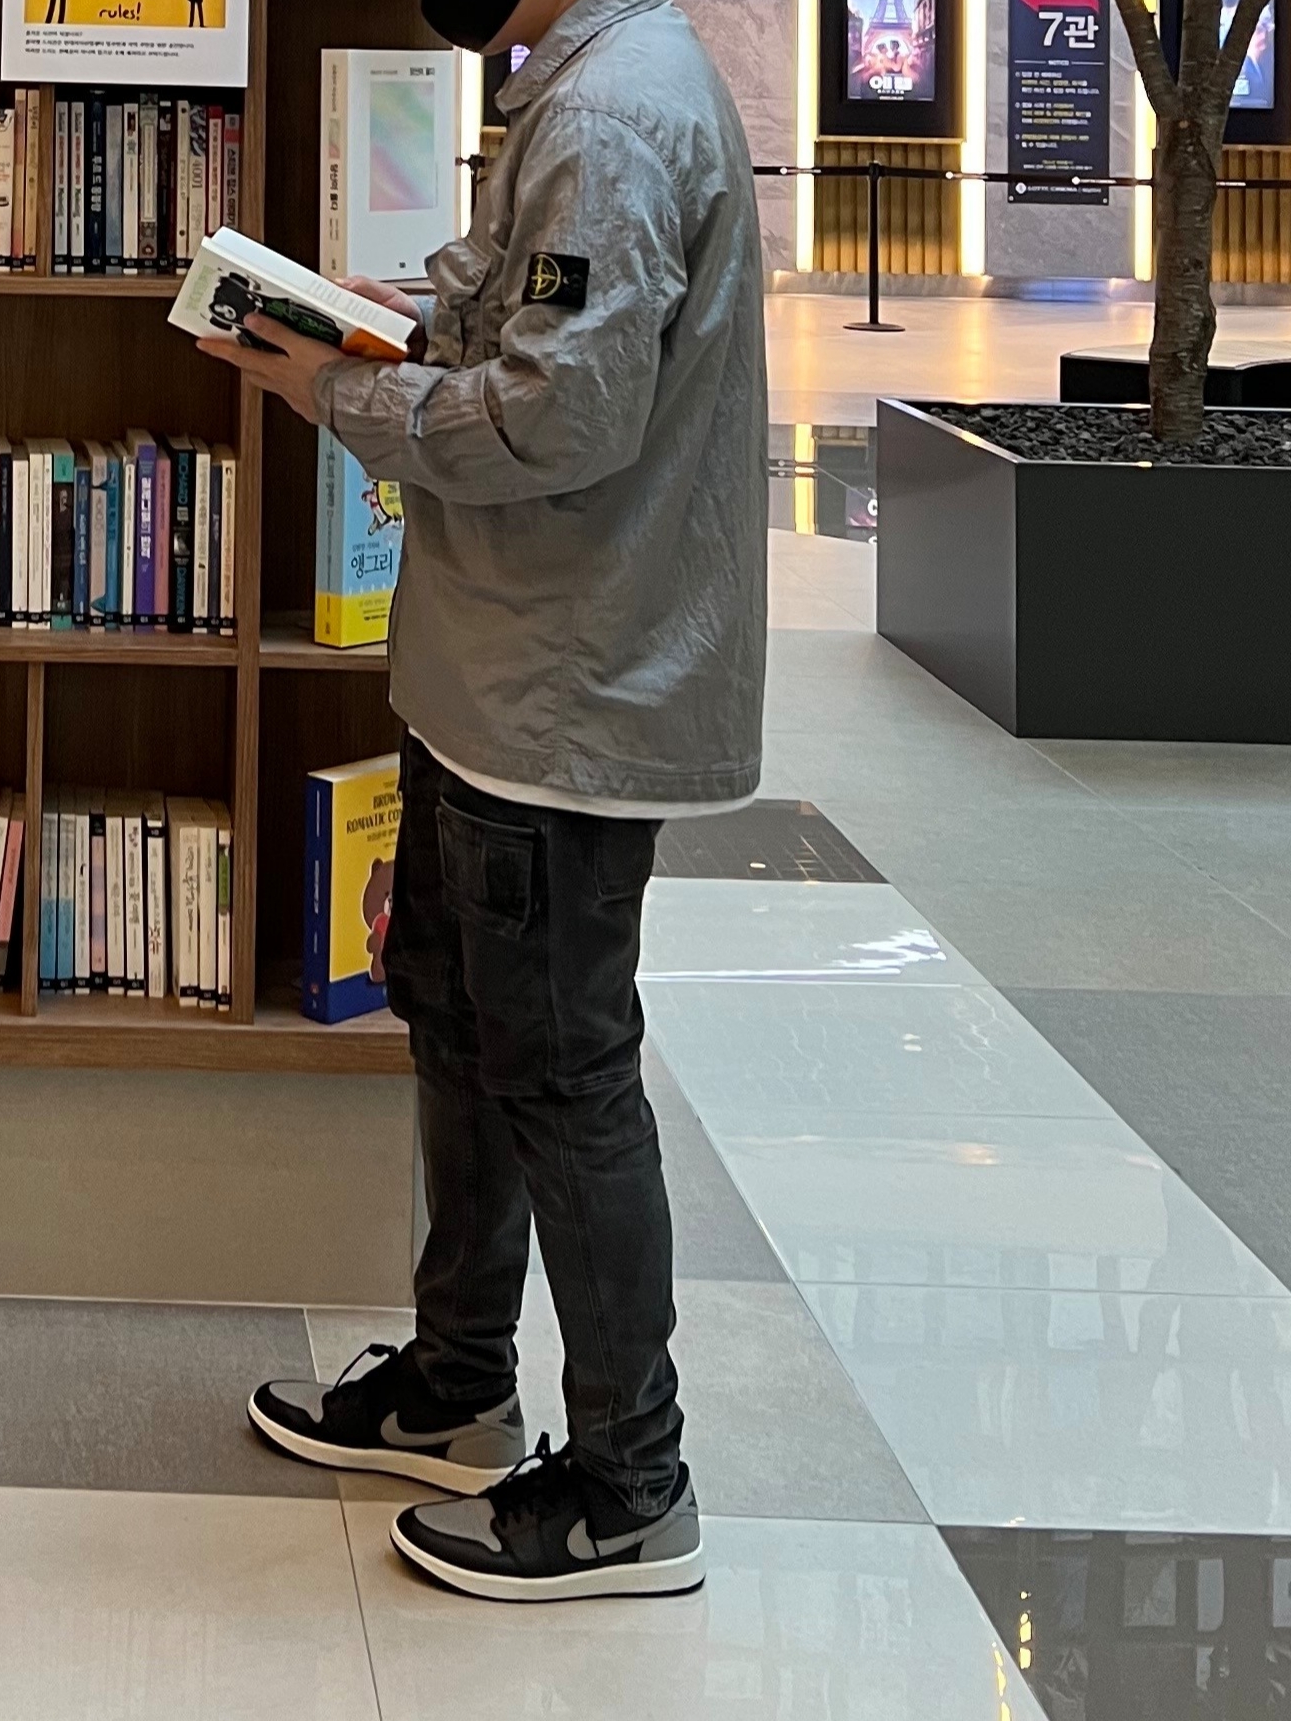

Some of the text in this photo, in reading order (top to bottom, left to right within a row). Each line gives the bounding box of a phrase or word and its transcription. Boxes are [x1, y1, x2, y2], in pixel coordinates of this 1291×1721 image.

[99, 2, 142, 21] rules!
[1038, 11, 1099, 49] 7관
[191, 159, 203, 189] 4001
[351, 550, 393, 579] 앵그리
[176, 567, 187, 615] DAWKIN
[346, 812, 386, 835] ROMANTIC
